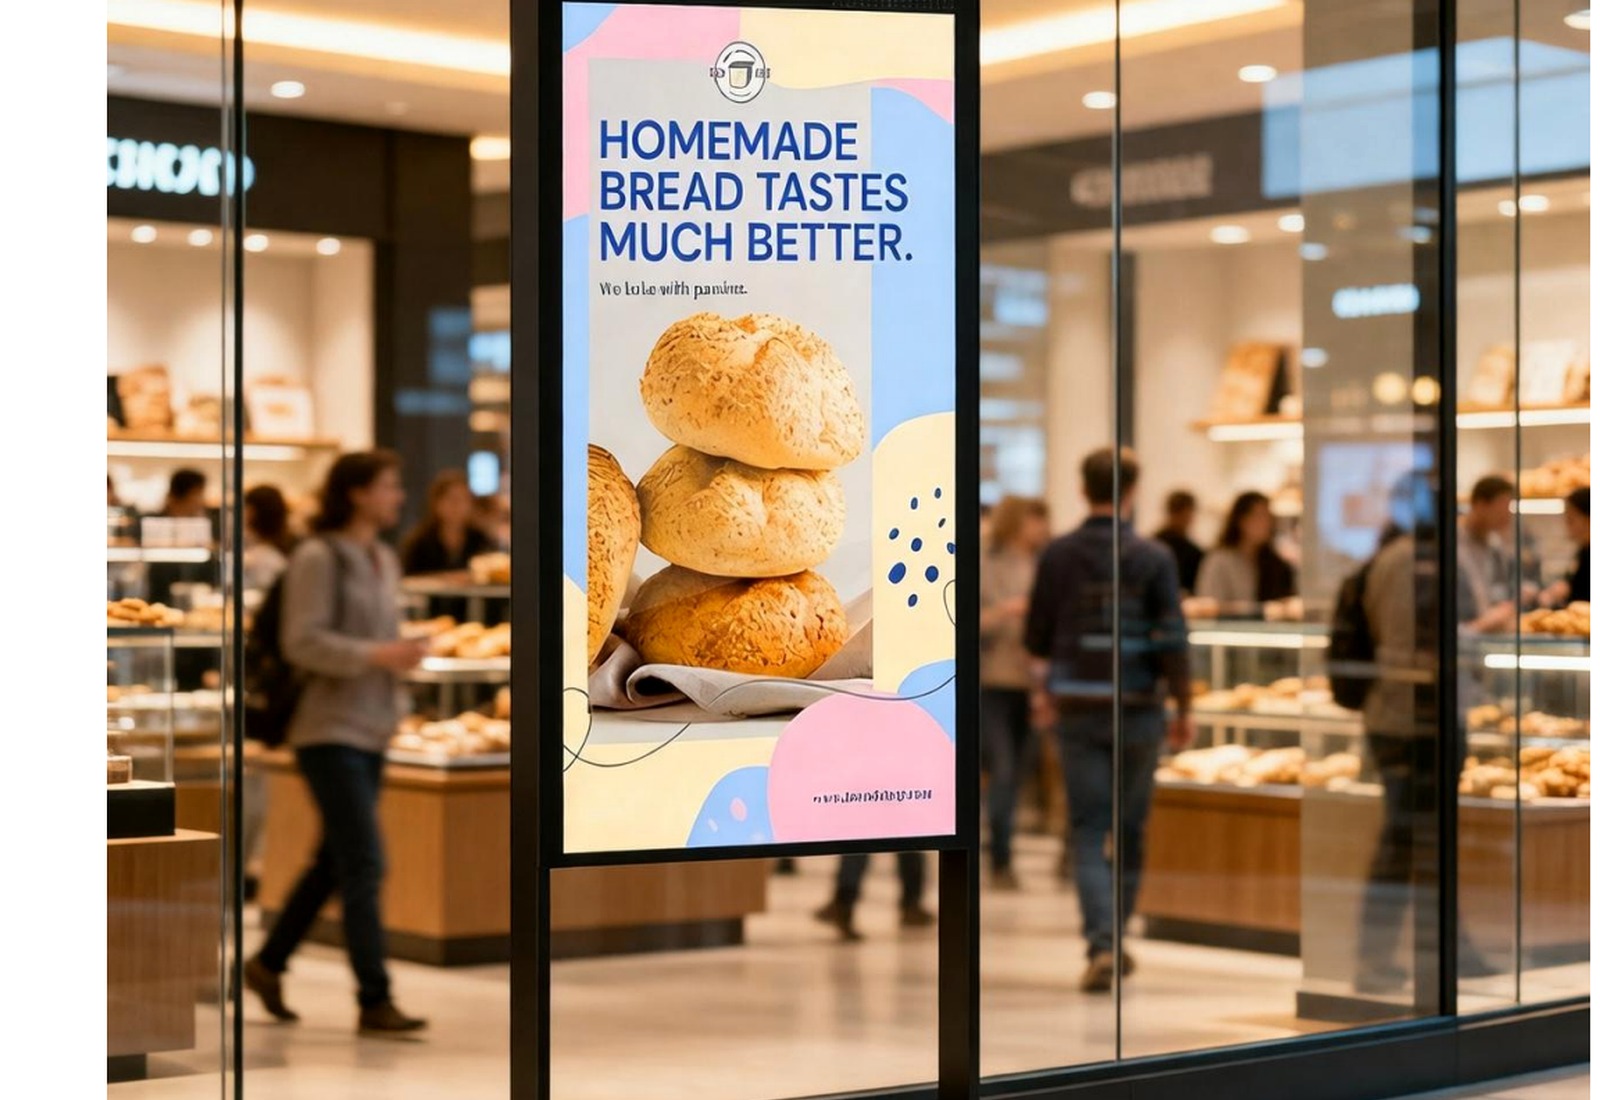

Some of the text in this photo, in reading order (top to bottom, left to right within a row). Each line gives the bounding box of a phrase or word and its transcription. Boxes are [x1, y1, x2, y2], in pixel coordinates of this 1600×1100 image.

[600, 119, 858, 161] HOMEMADE
[600, 171, 909, 213] BREAD TASTES
[600, 221, 913, 262] MUCH BETTER.
